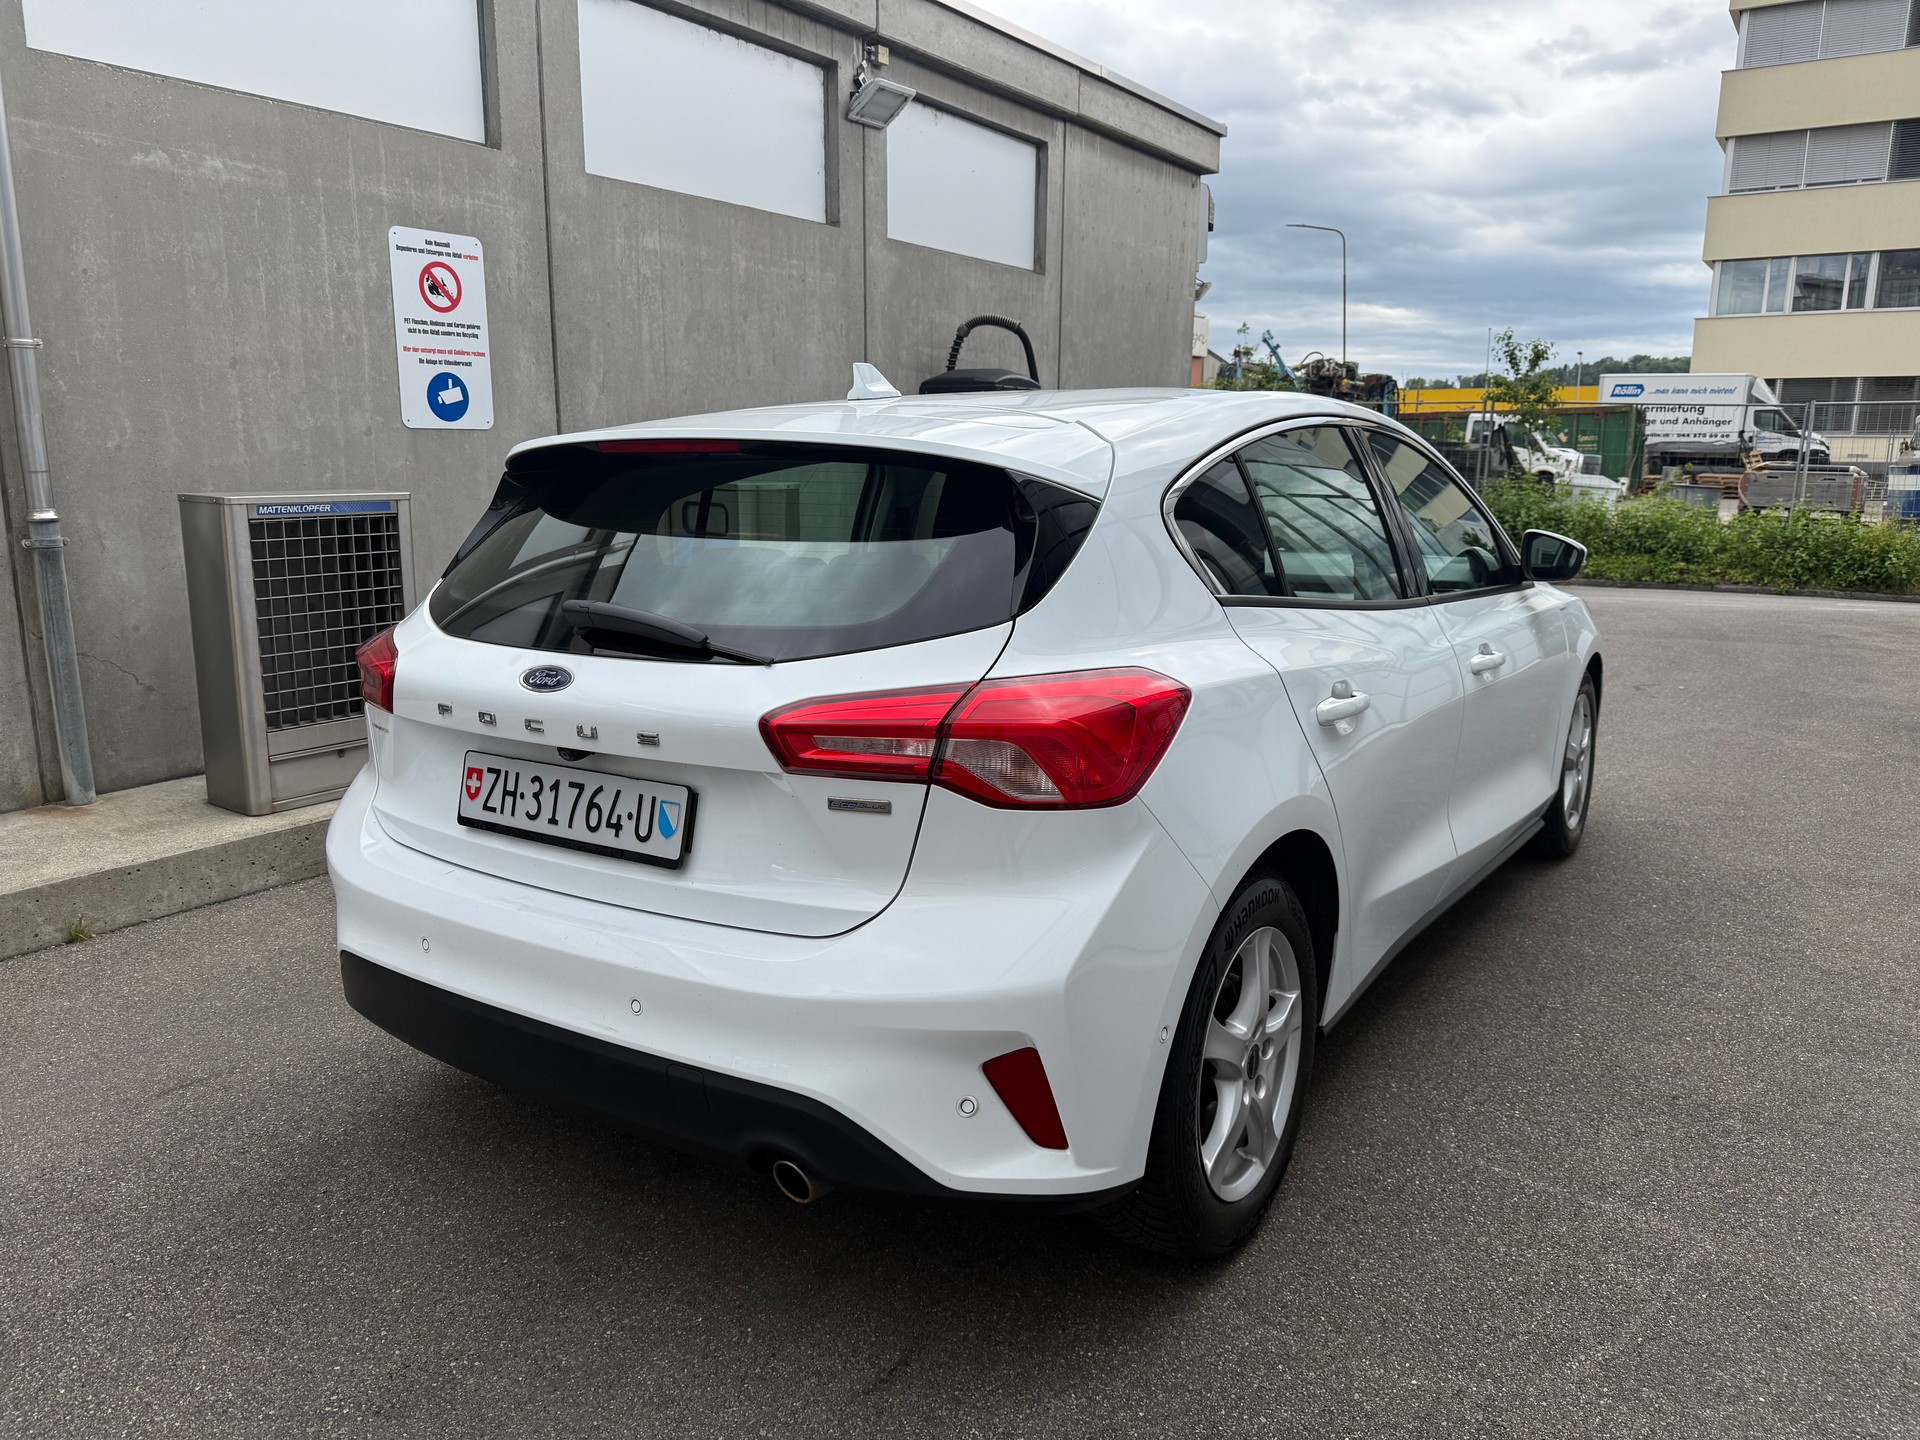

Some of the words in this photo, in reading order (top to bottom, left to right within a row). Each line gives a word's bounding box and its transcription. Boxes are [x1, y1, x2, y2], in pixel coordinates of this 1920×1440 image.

[1613, 386, 1642, 395] Röllin
[1682, 417, 1732, 427] Anhänger
[259, 504, 331, 514] MATTENKLOPFER
[529, 669, 561, 686] Ford
[438, 703, 660, 746] FOCUS
